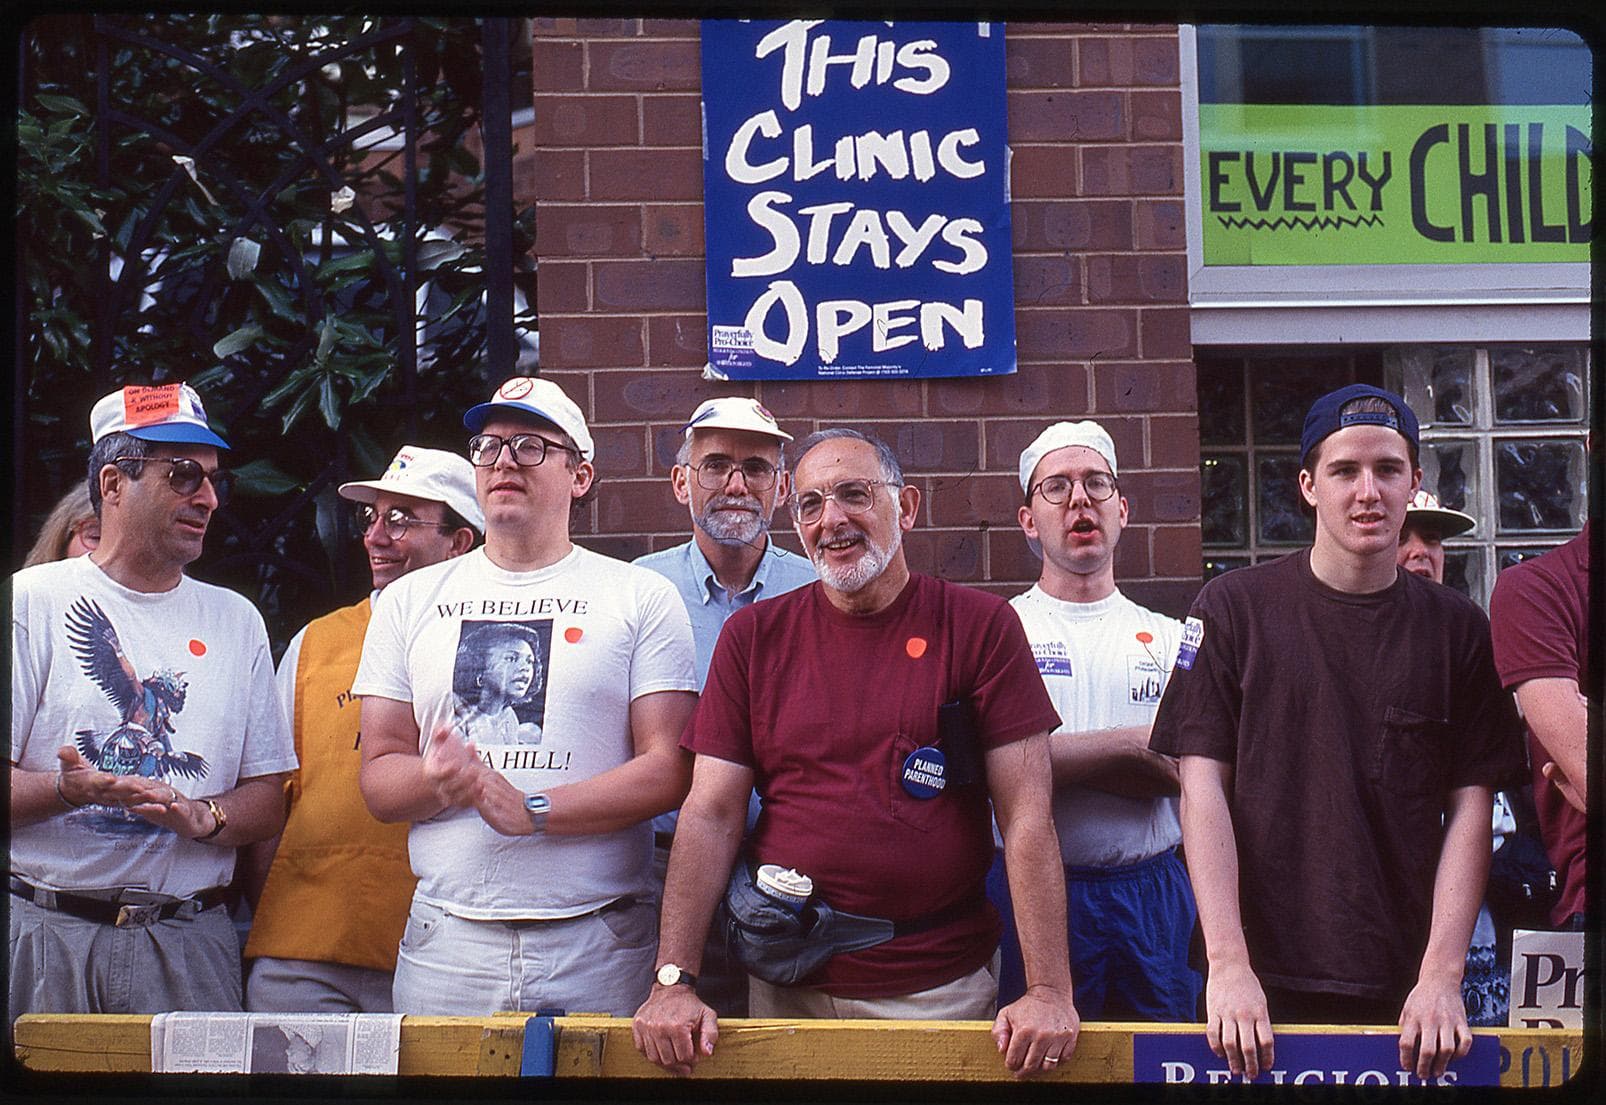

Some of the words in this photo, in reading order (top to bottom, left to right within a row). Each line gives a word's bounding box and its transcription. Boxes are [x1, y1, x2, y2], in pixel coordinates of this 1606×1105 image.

[756, 19, 951, 111] THIS
[725, 109, 986, 184] CLINIC
[1208, 151, 1392, 212] EVERY
[1409, 123, 1592, 244] CHILD
[731, 190, 989, 277] STAYS
[744, 280, 985, 366] OPEN
[136, 401, 169, 412] APOLOGY
[437, 601, 473, 619] WE
[481, 598, 588, 616] BELIEVE
[501, 750, 571, 770] HILL!
[904, 768, 946, 789] PARENTHOOD
[913, 758, 944, 776] PLANNED
